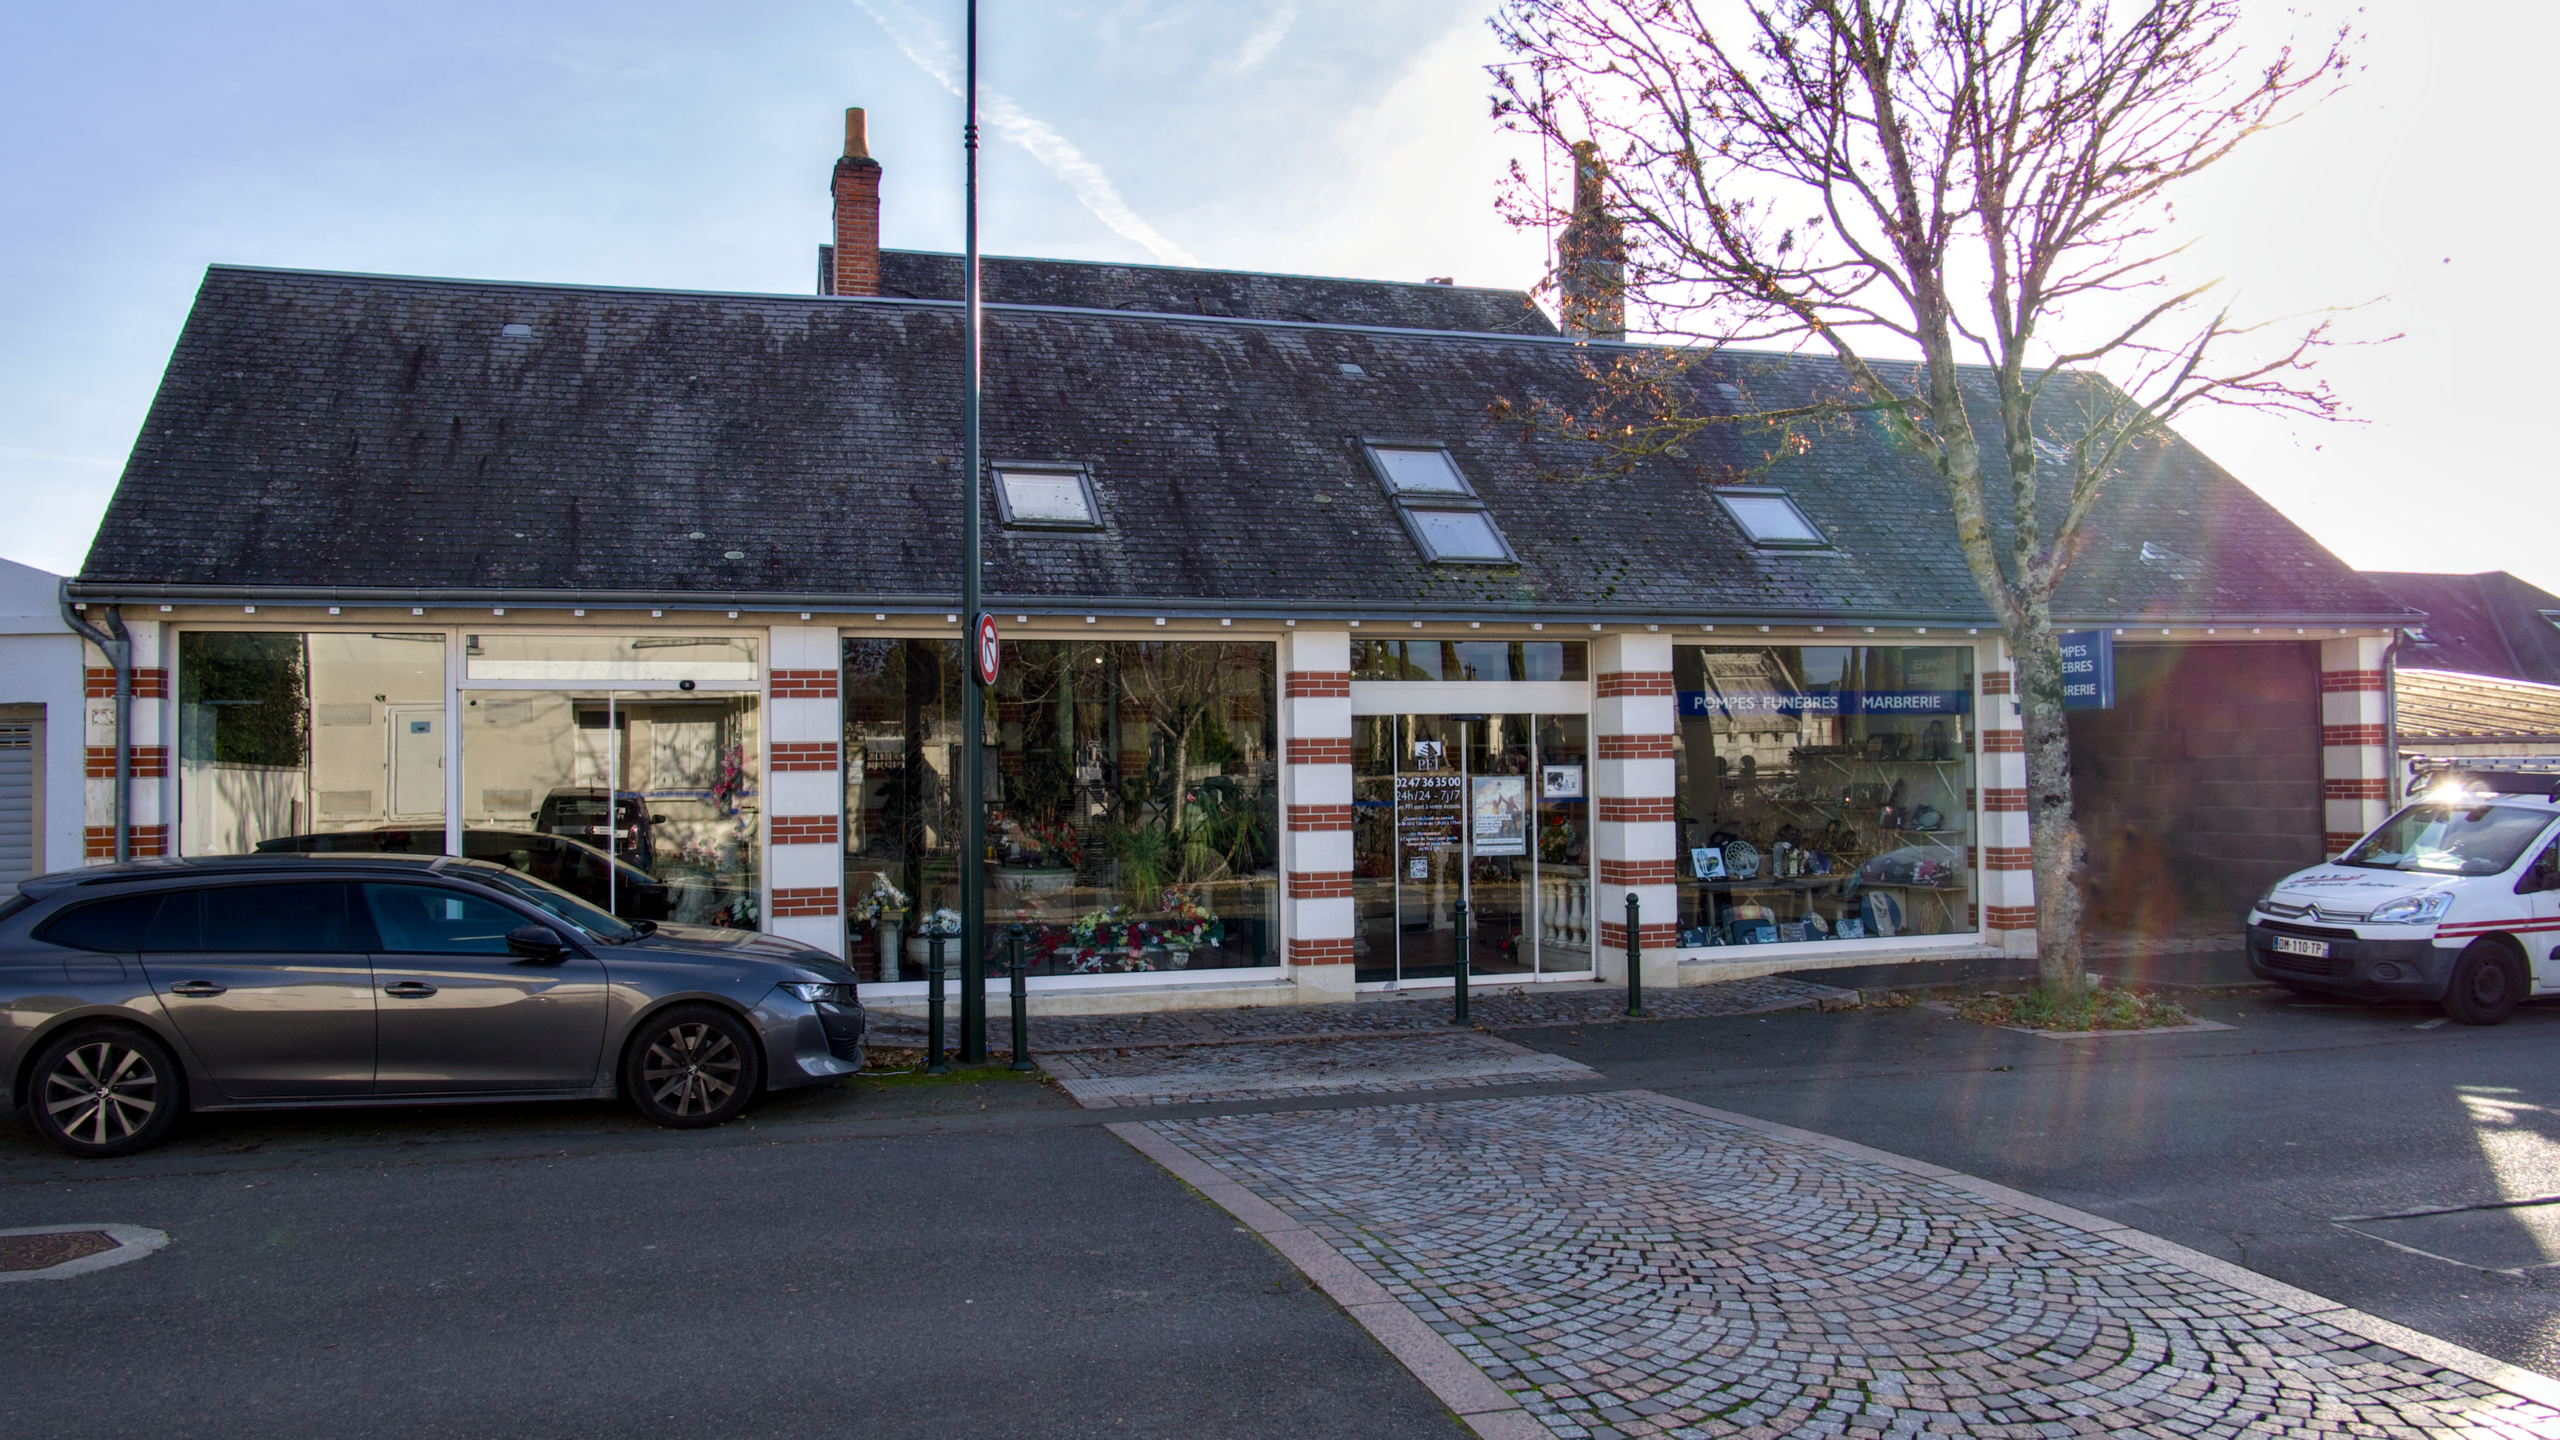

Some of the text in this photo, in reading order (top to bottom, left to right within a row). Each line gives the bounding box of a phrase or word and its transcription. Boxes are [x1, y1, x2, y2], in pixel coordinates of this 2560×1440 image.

[2060, 645, 2087, 658] MPES
[2061, 660, 2093, 673] EBRES
[2063, 683, 2096, 696] BRERIE
[1694, 695, 1941, 710] POMPES FUNEBRES MARBRERIE
[1418, 759, 1440, 770] PFI
[1396, 776, 1461, 788] 02 47 36 35 00
[1440, 789, 1461, 803] 7j/7
[2278, 938, 2321, 954] DM-110-TP
